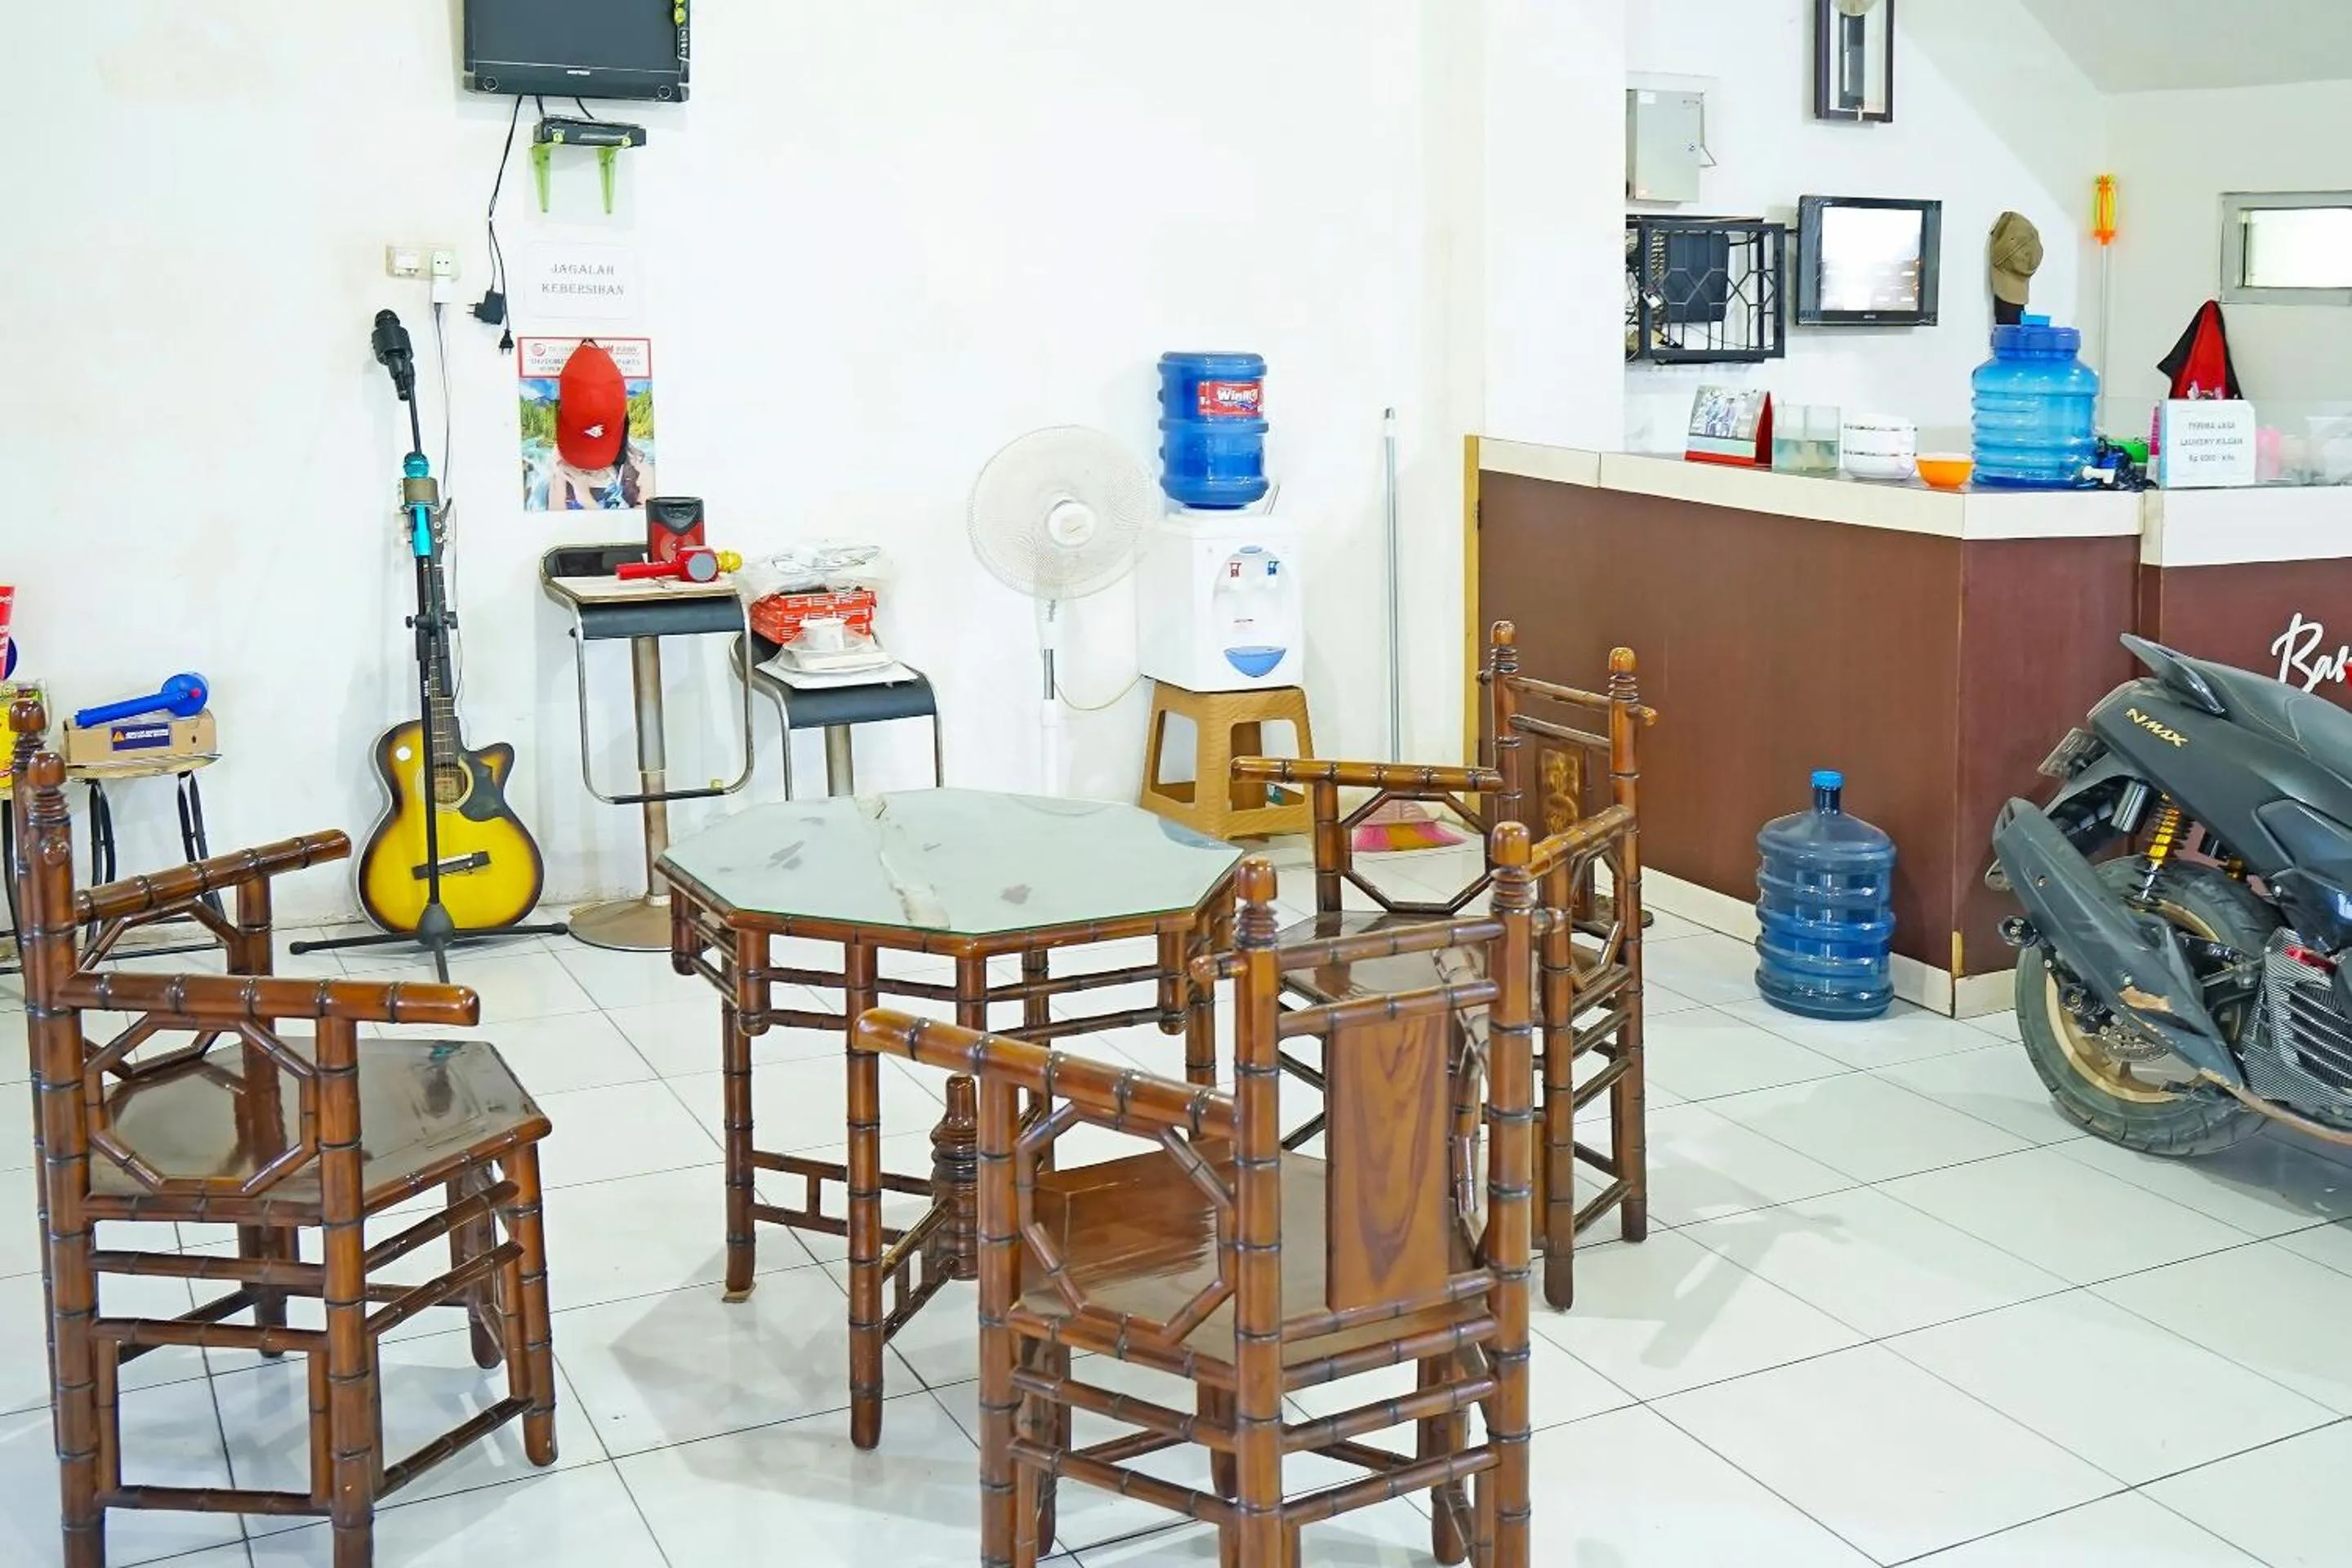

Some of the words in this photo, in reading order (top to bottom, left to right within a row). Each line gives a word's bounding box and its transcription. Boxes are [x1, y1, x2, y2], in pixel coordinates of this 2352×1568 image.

[551, 263, 614, 275] JAGALAH
[541, 283, 625, 295] KEBERSIHAN
[2126, 708, 2189, 747] NMAX
